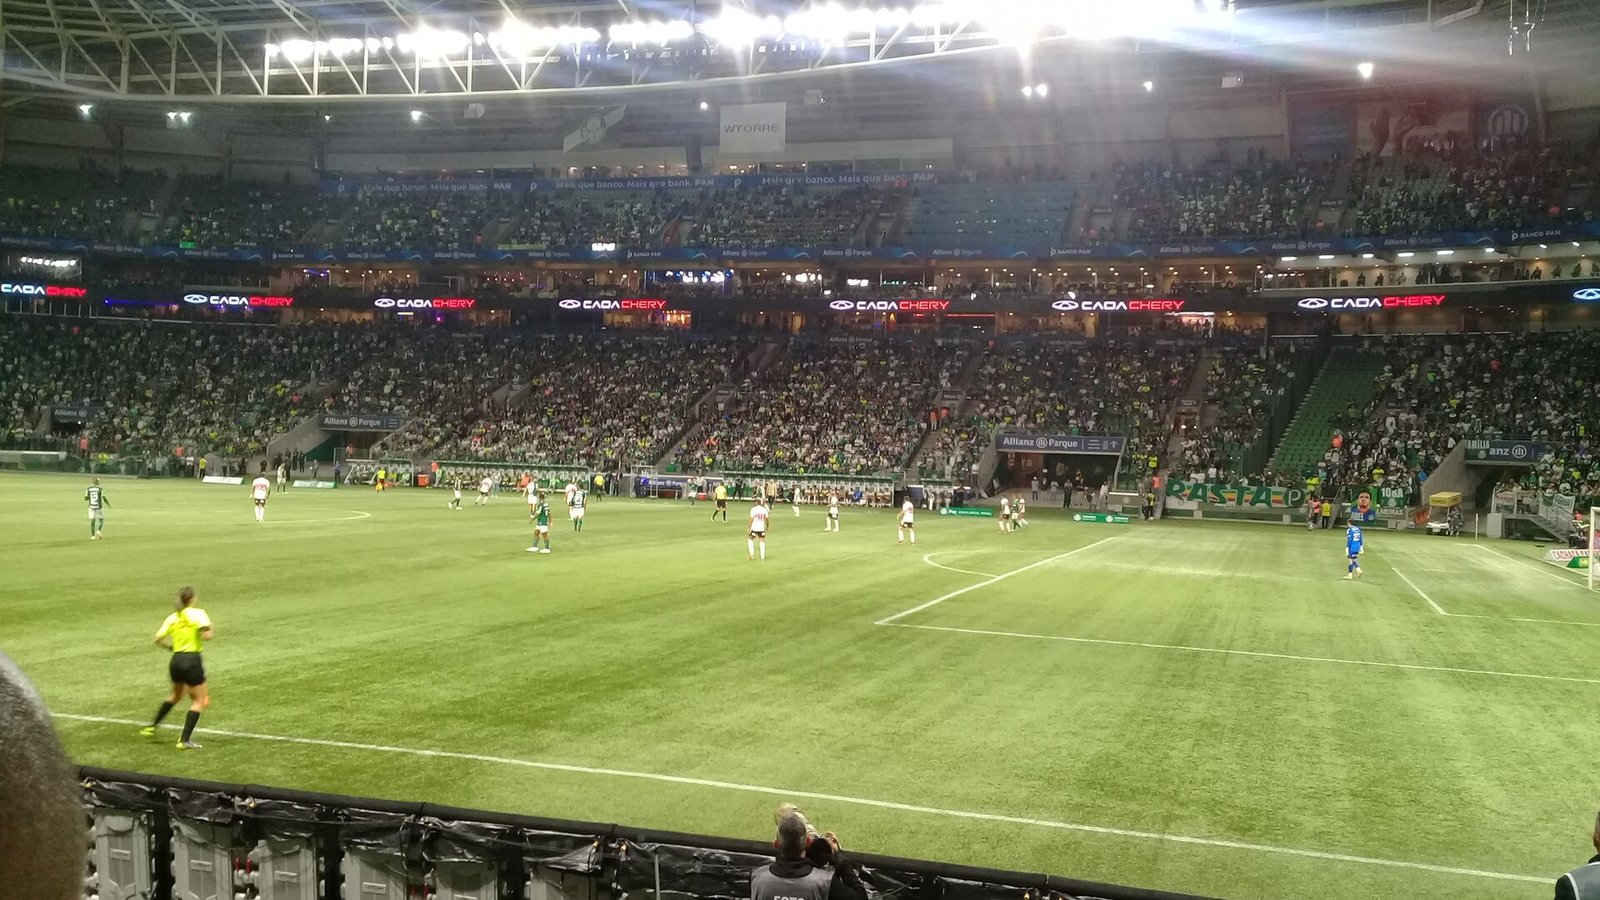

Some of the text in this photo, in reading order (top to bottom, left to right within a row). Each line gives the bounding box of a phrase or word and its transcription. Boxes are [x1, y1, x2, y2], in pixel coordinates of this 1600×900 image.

[724, 124, 778, 133] WTORRE
[578, 181, 594, 191] que
[627, 179, 647, 188] Mais
[695, 177, 714, 186] PAN
[838, 175, 860, 183] Mais
[862, 175, 881, 184] que
[1271, 240, 1331, 251] Allianz Parque
[1384, 238, 1408, 246] Allianz
[823, 249, 845, 257] Allianz
[1160, 246, 1182, 254] Allianz
[54, 409, 77, 417] Allianz
[324, 417, 348, 426] Allianz
[358, 418, 381, 428] Parque
[1003, 436, 1034, 448] Allianz
[1048, 438, 1078, 450] Parque
